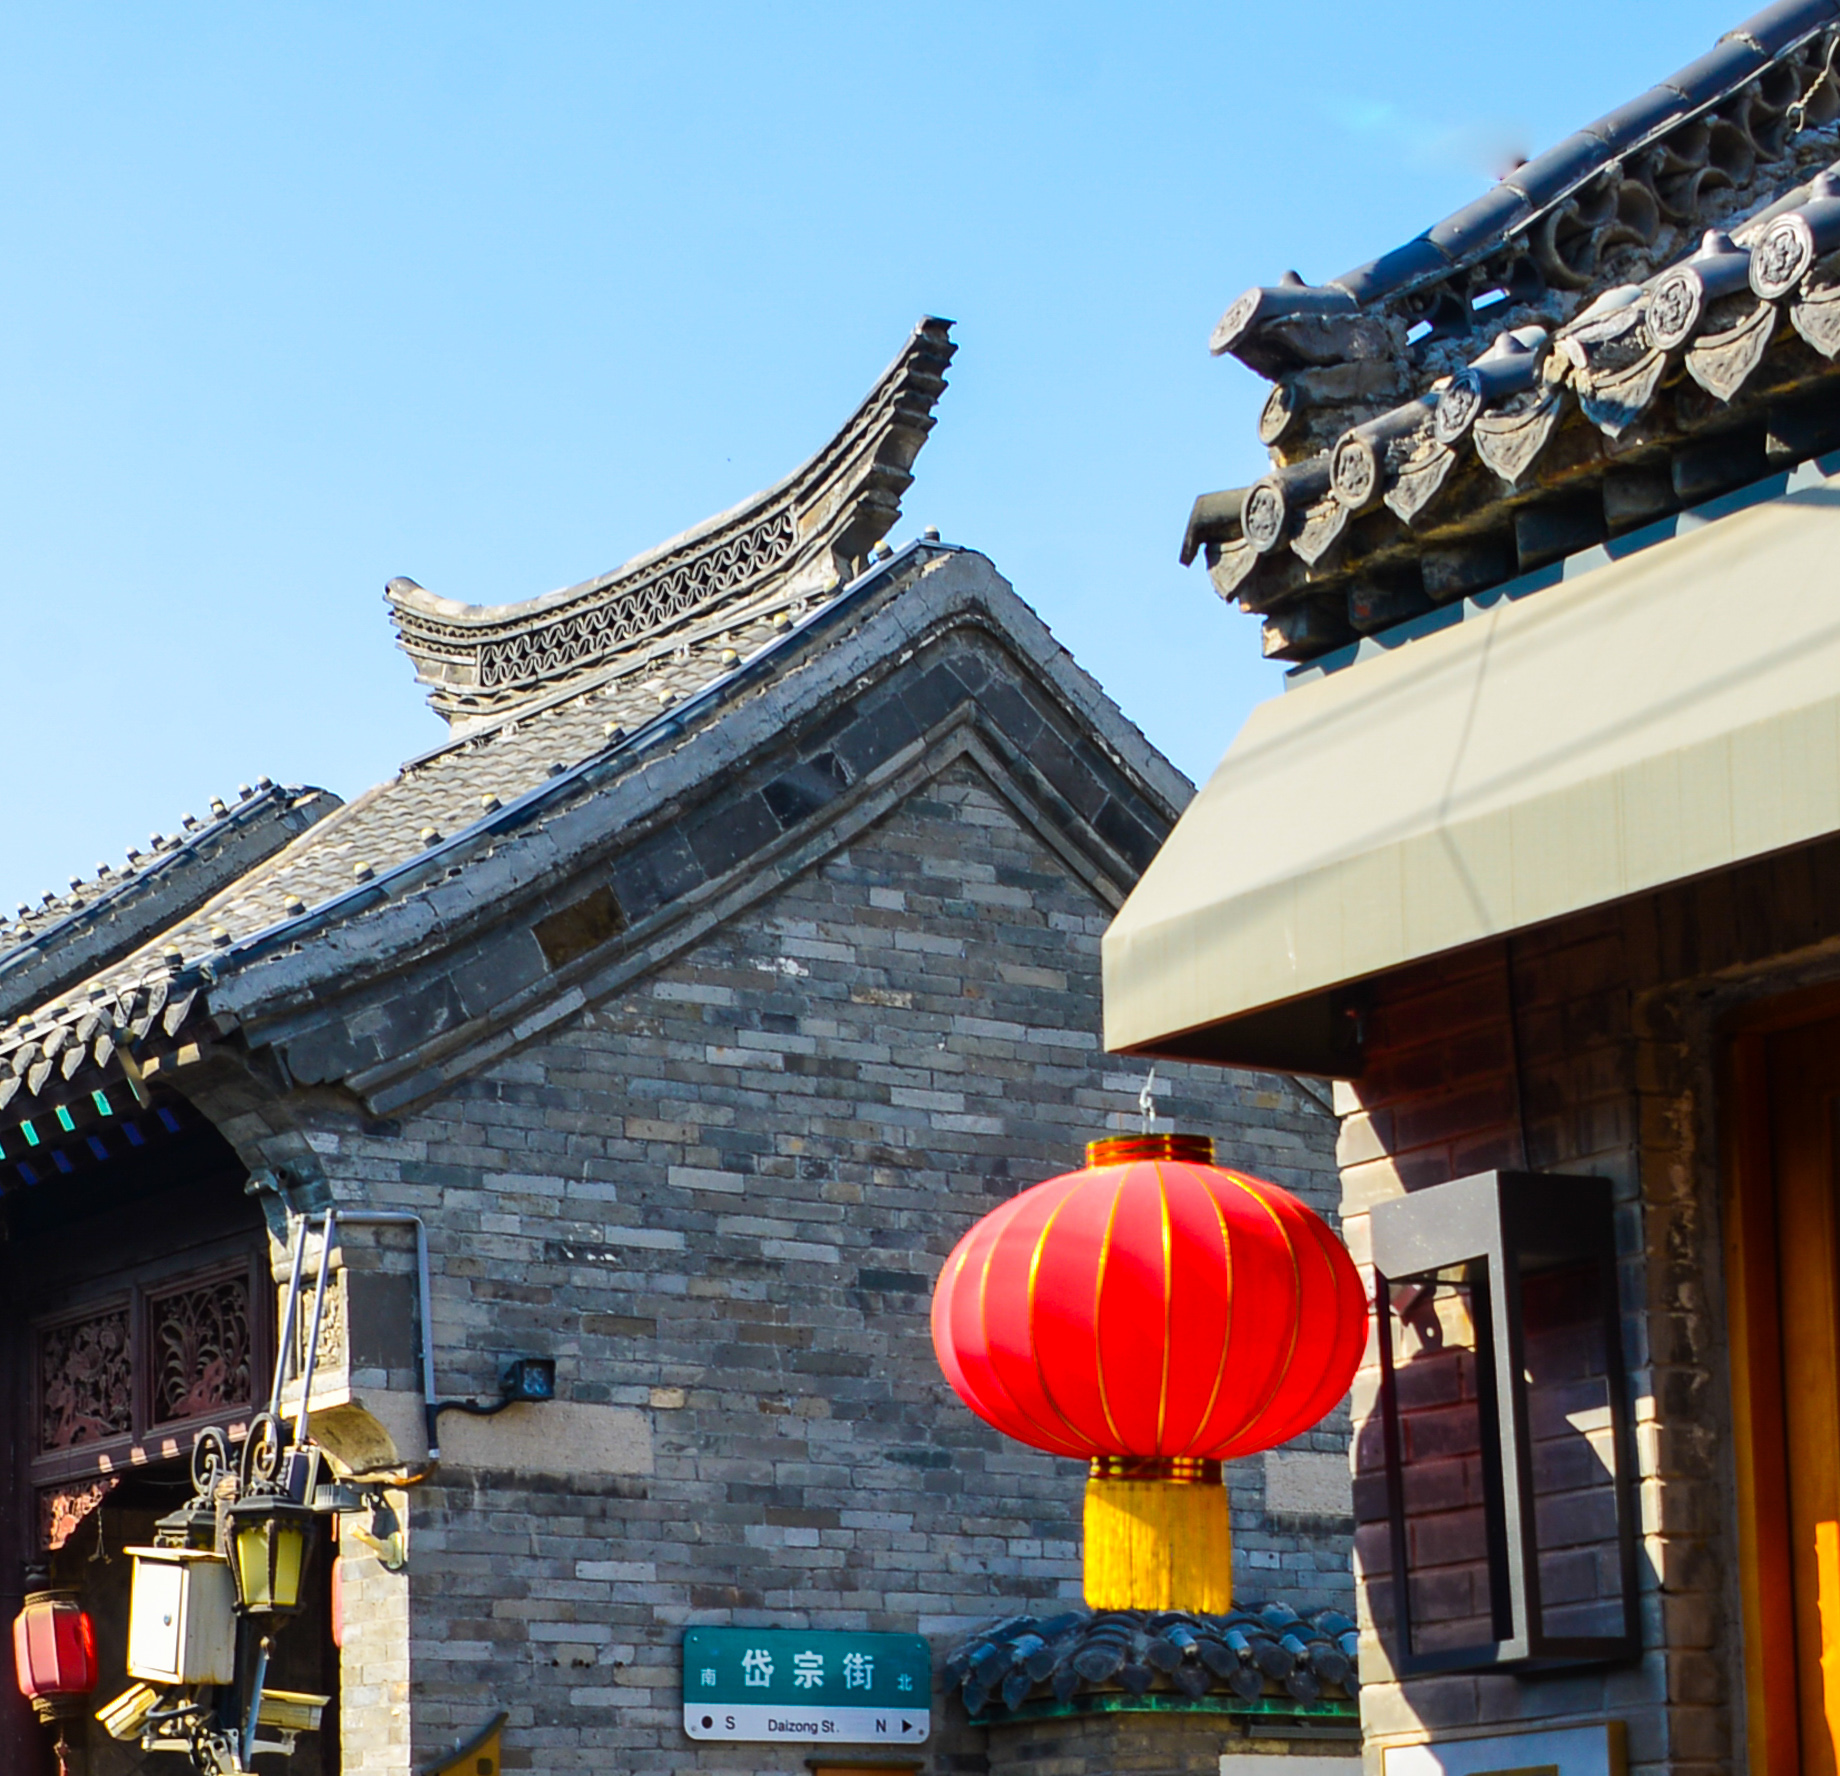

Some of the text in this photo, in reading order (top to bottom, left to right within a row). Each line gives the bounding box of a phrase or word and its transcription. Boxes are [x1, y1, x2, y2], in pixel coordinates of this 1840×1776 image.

[700, 1649, 913, 1691] 南 岱宗街 北
[725, 1716, 887, 1735] S Daizong St. N
